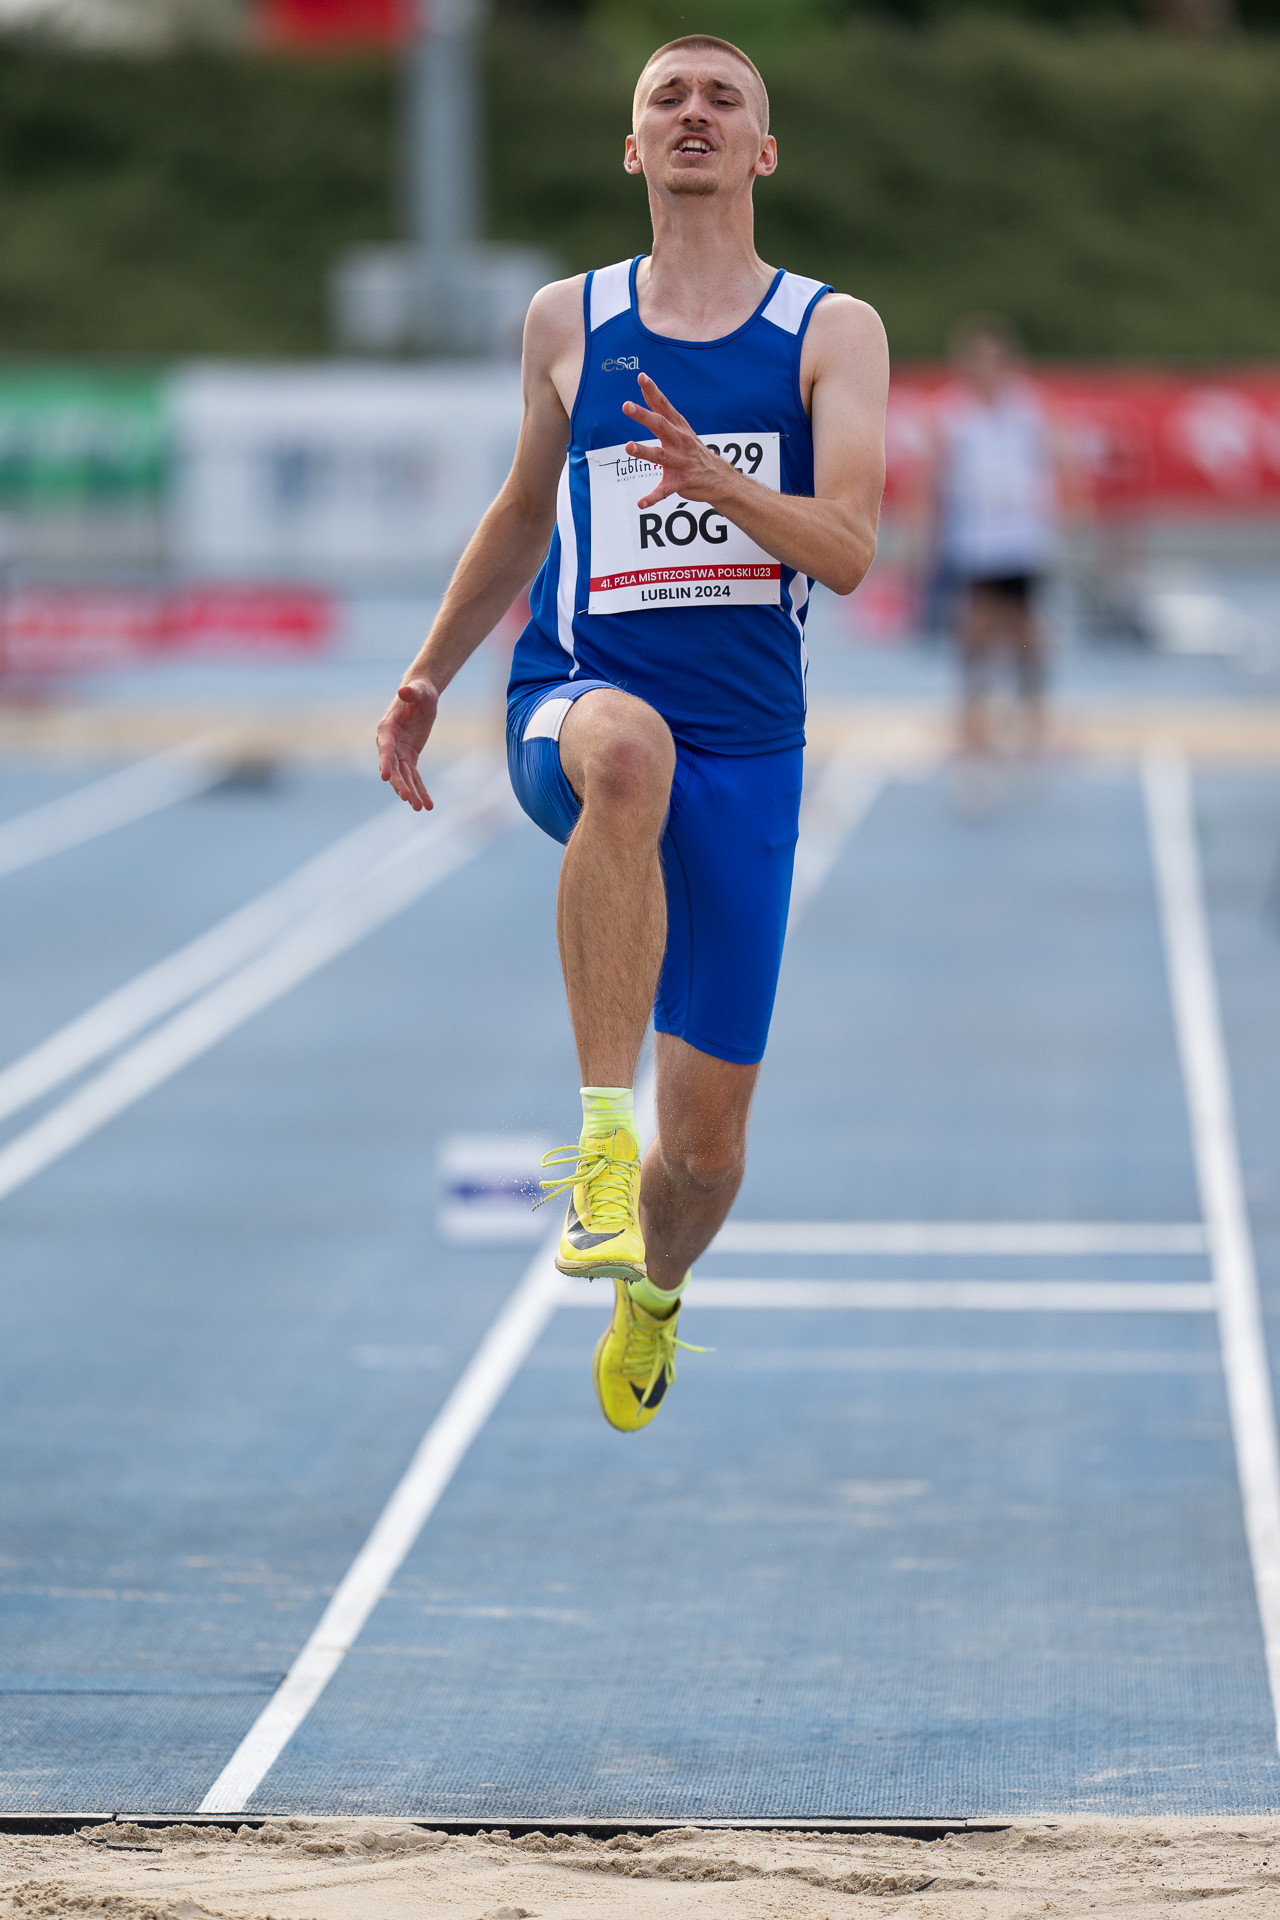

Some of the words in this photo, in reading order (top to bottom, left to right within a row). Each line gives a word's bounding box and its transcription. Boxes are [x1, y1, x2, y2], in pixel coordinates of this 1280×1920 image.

[639, 502, 728, 549] RÓG
[600, 578, 613, 588] 41.
[614, 574, 637, 586] PZLA
[638, 568, 716, 582] MISTRZOSTWA
[717, 568, 751, 577] POLSKI
[753, 567, 771, 577] U23
[641, 587, 691, 601] LUBLIN
[695, 585, 731, 598] 2024
